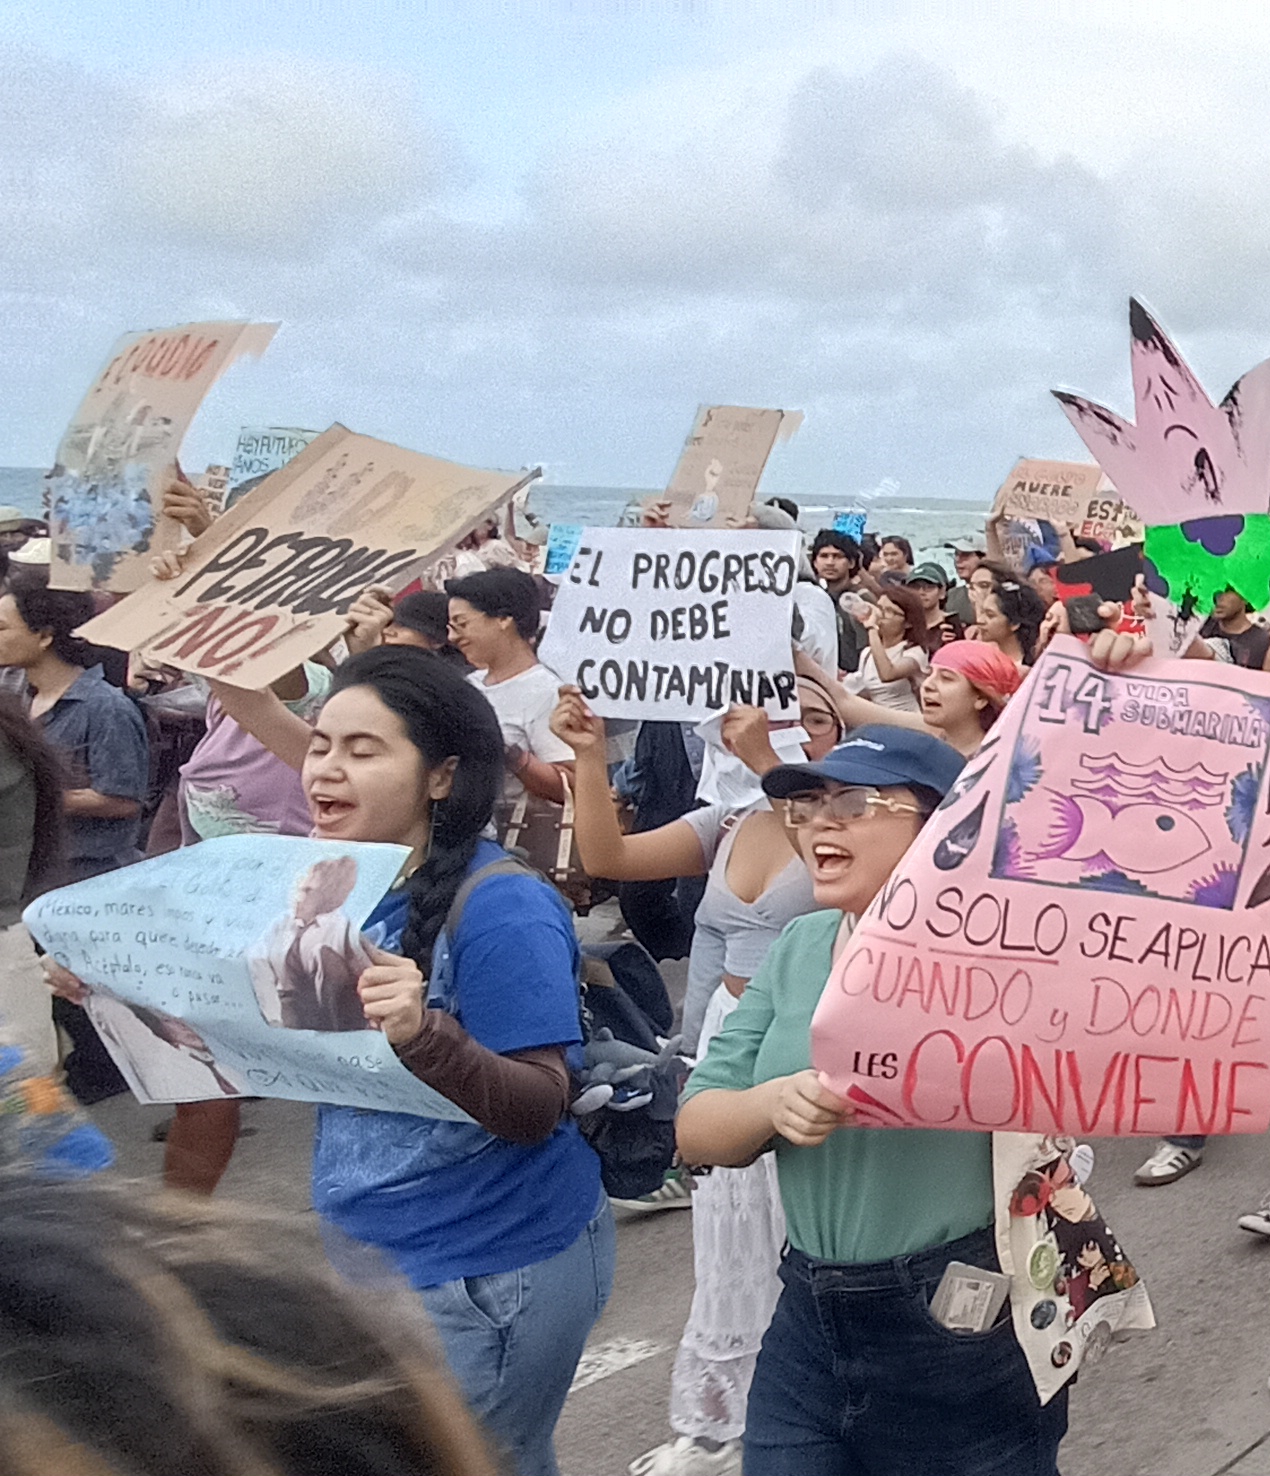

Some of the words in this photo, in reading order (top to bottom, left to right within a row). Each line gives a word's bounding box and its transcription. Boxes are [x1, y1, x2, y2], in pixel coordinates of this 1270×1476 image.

[1013, 480, 1073, 497] MUERE
[569, 547, 603, 587] EL
[632, 549, 796, 596] PROGRESO
[579, 606, 632, 643] NO
[650, 600, 731, 641] DEBE
[576, 658, 798, 710] CONTAMINAR
[1039, 664, 1114, 735] 14
[1126, 683, 1190, 707] VIDA
[1120, 700, 1263, 748] SUBMARINA
[104, 901, 154, 917] mares
[868, 875, 917, 931] NO
[926, 886, 1068, 956] SOLO
[1080, 912, 1137, 963] SE
[841, 946, 1034, 1027] CUANDO
[1085, 976, 1267, 1049] DONDE
[852, 1050, 898, 1079] LES
[901, 1028, 1269, 1135] CONVIENE
